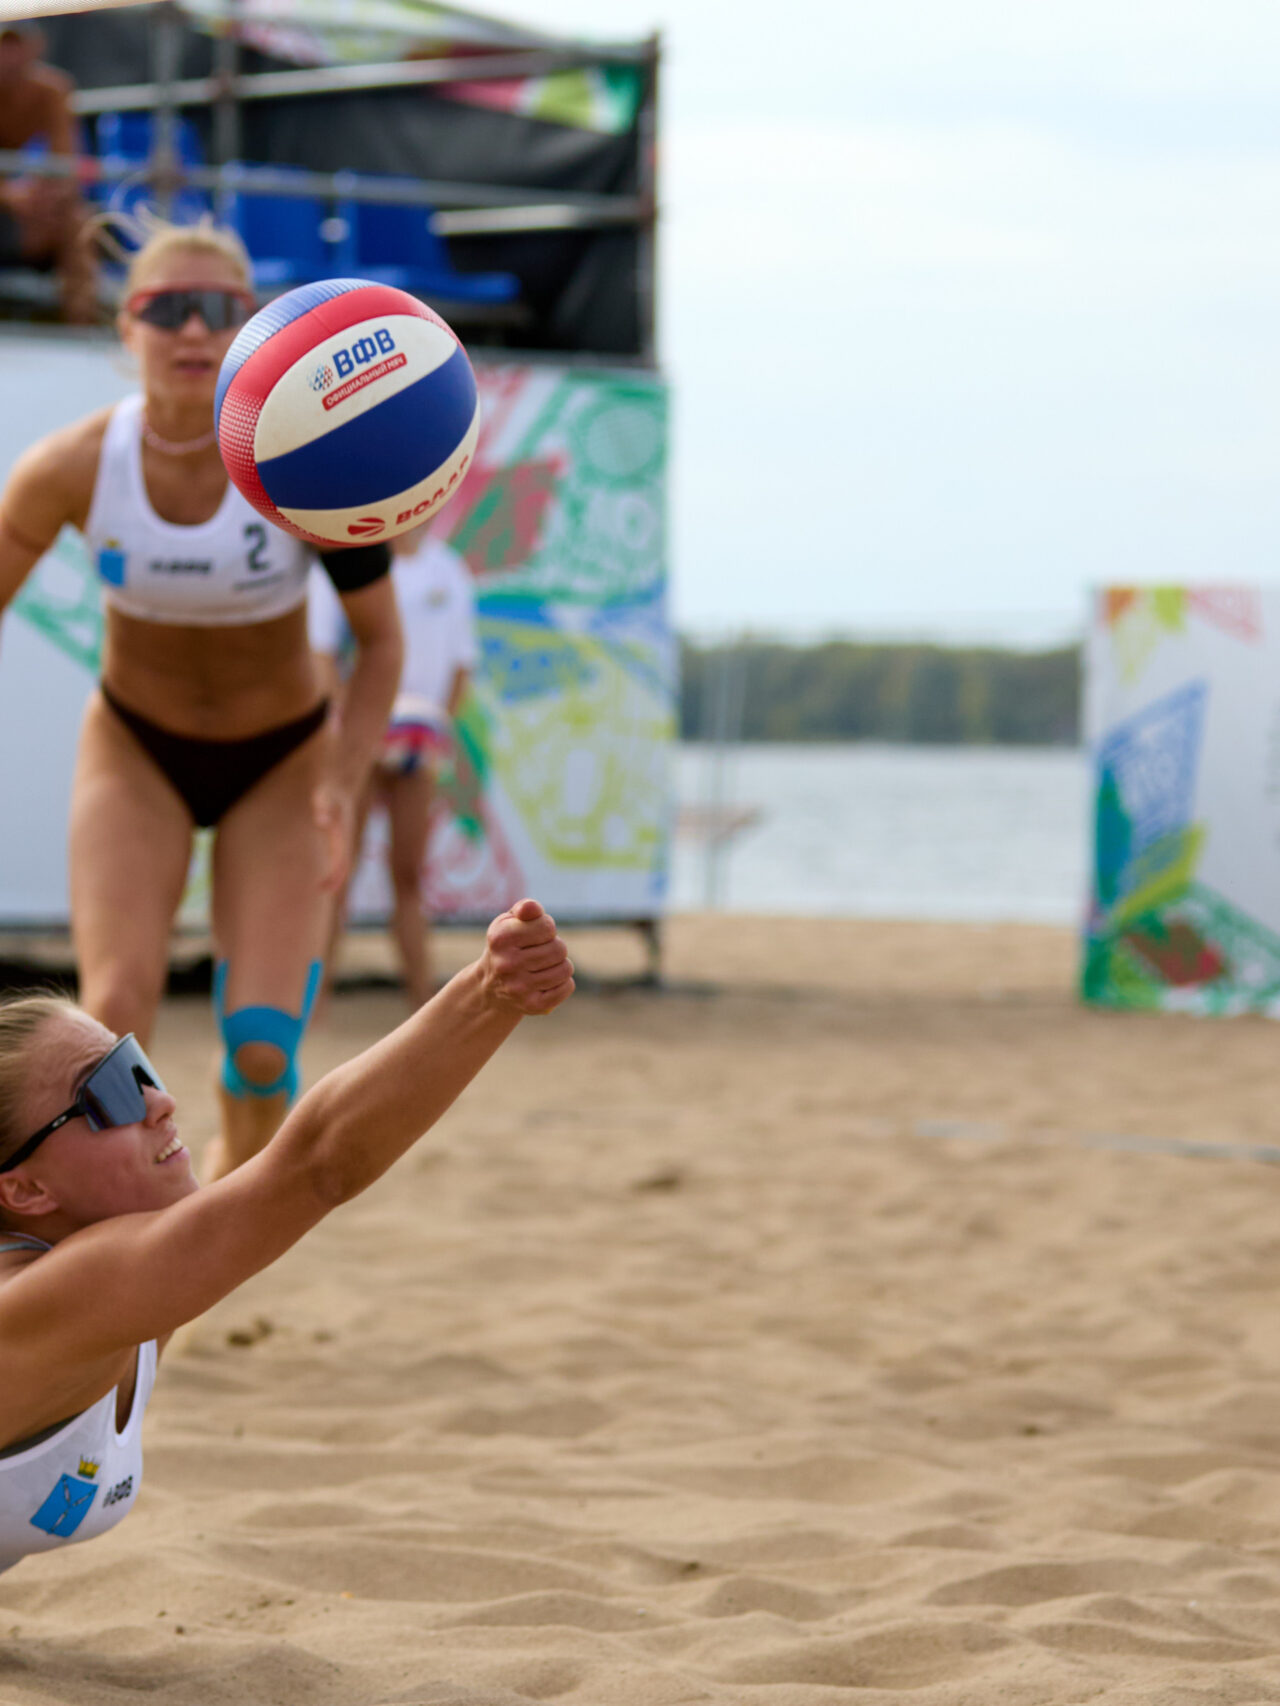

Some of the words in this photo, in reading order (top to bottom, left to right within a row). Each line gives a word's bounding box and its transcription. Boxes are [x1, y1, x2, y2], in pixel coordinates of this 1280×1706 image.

[333, 328, 395, 378] ВФВ
[326, 362, 389, 406] ОФИЦИАЛЬНЫЙ
[244, 524, 271, 573] 2
